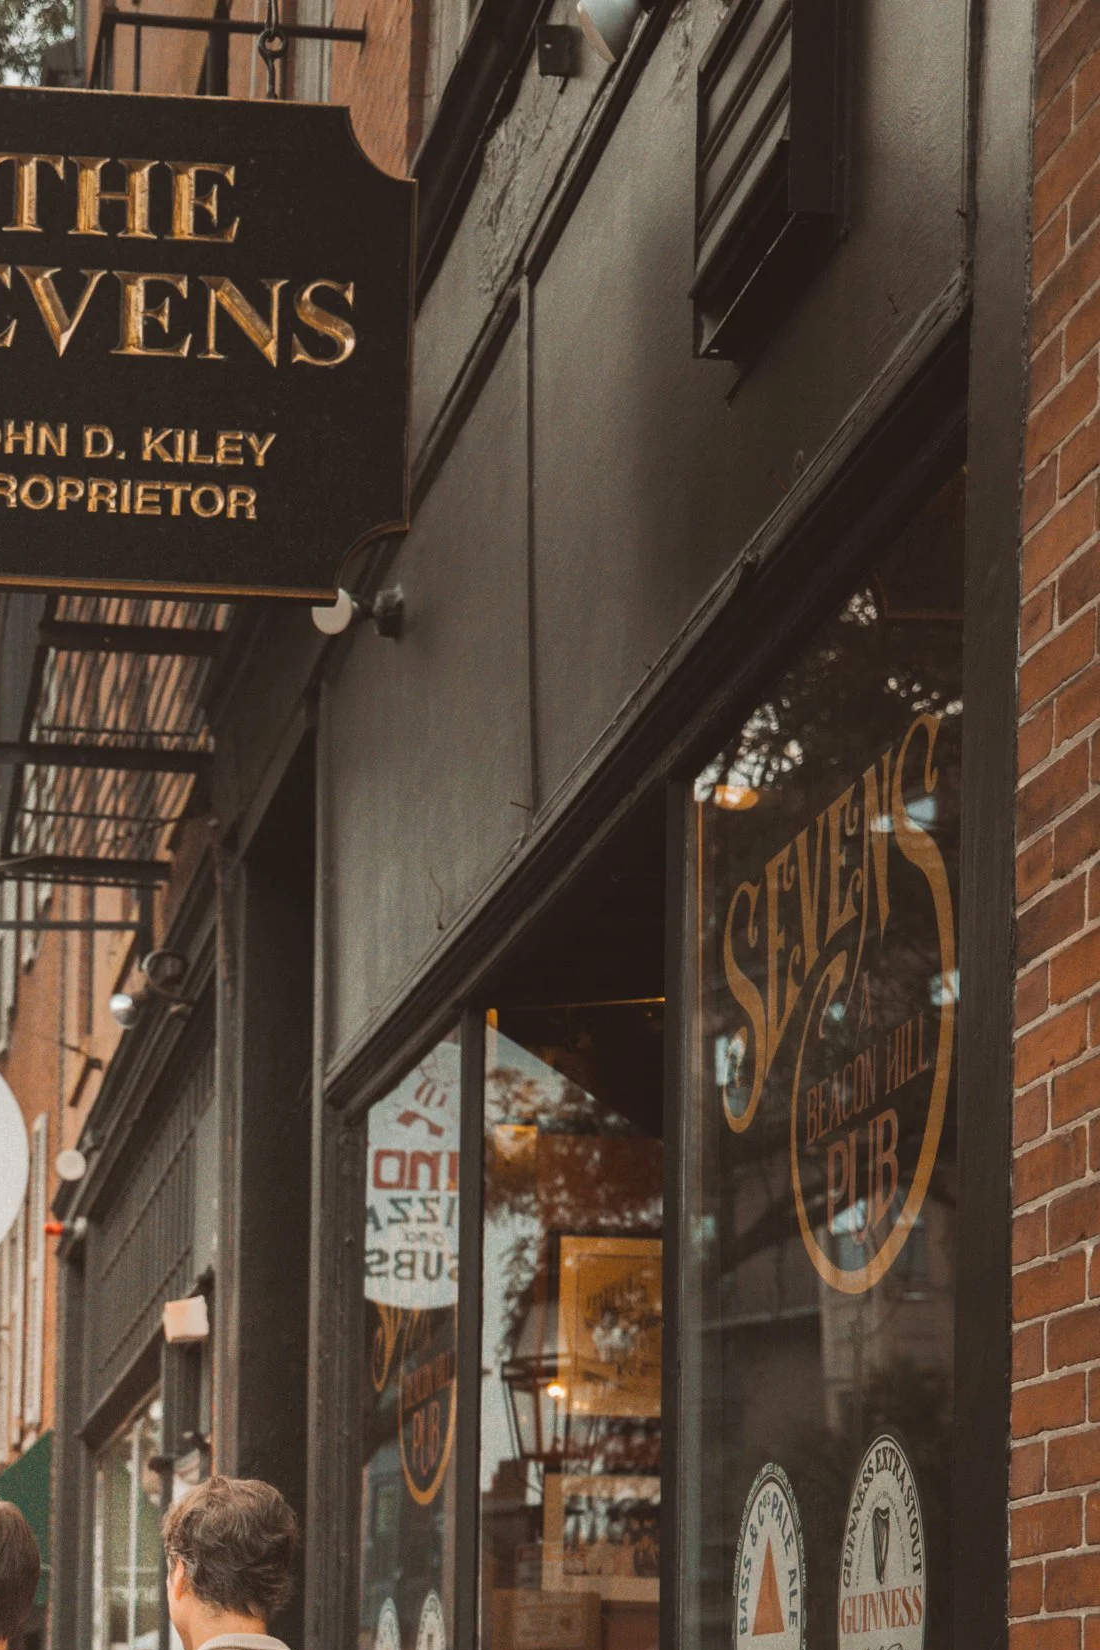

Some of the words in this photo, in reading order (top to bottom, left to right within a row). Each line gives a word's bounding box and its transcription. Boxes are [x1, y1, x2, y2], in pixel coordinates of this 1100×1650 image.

[83, 425, 126, 461] D.
[142, 428, 277, 468] KILEY
[805, 1044, 877, 1147] BEACON
[885, 1010, 930, 1096] HILL
[827, 1107, 899, 1246] PUB
[739, 1553, 753, 1637] BASS
[770, 1491, 795, 1557] PALE
[843, 1460, 875, 1589] GUINNESS
[875, 1446, 906, 1494] EXTRA
[904, 1485, 923, 1577] STOUT
[840, 1584, 923, 1635] GUINNESS
